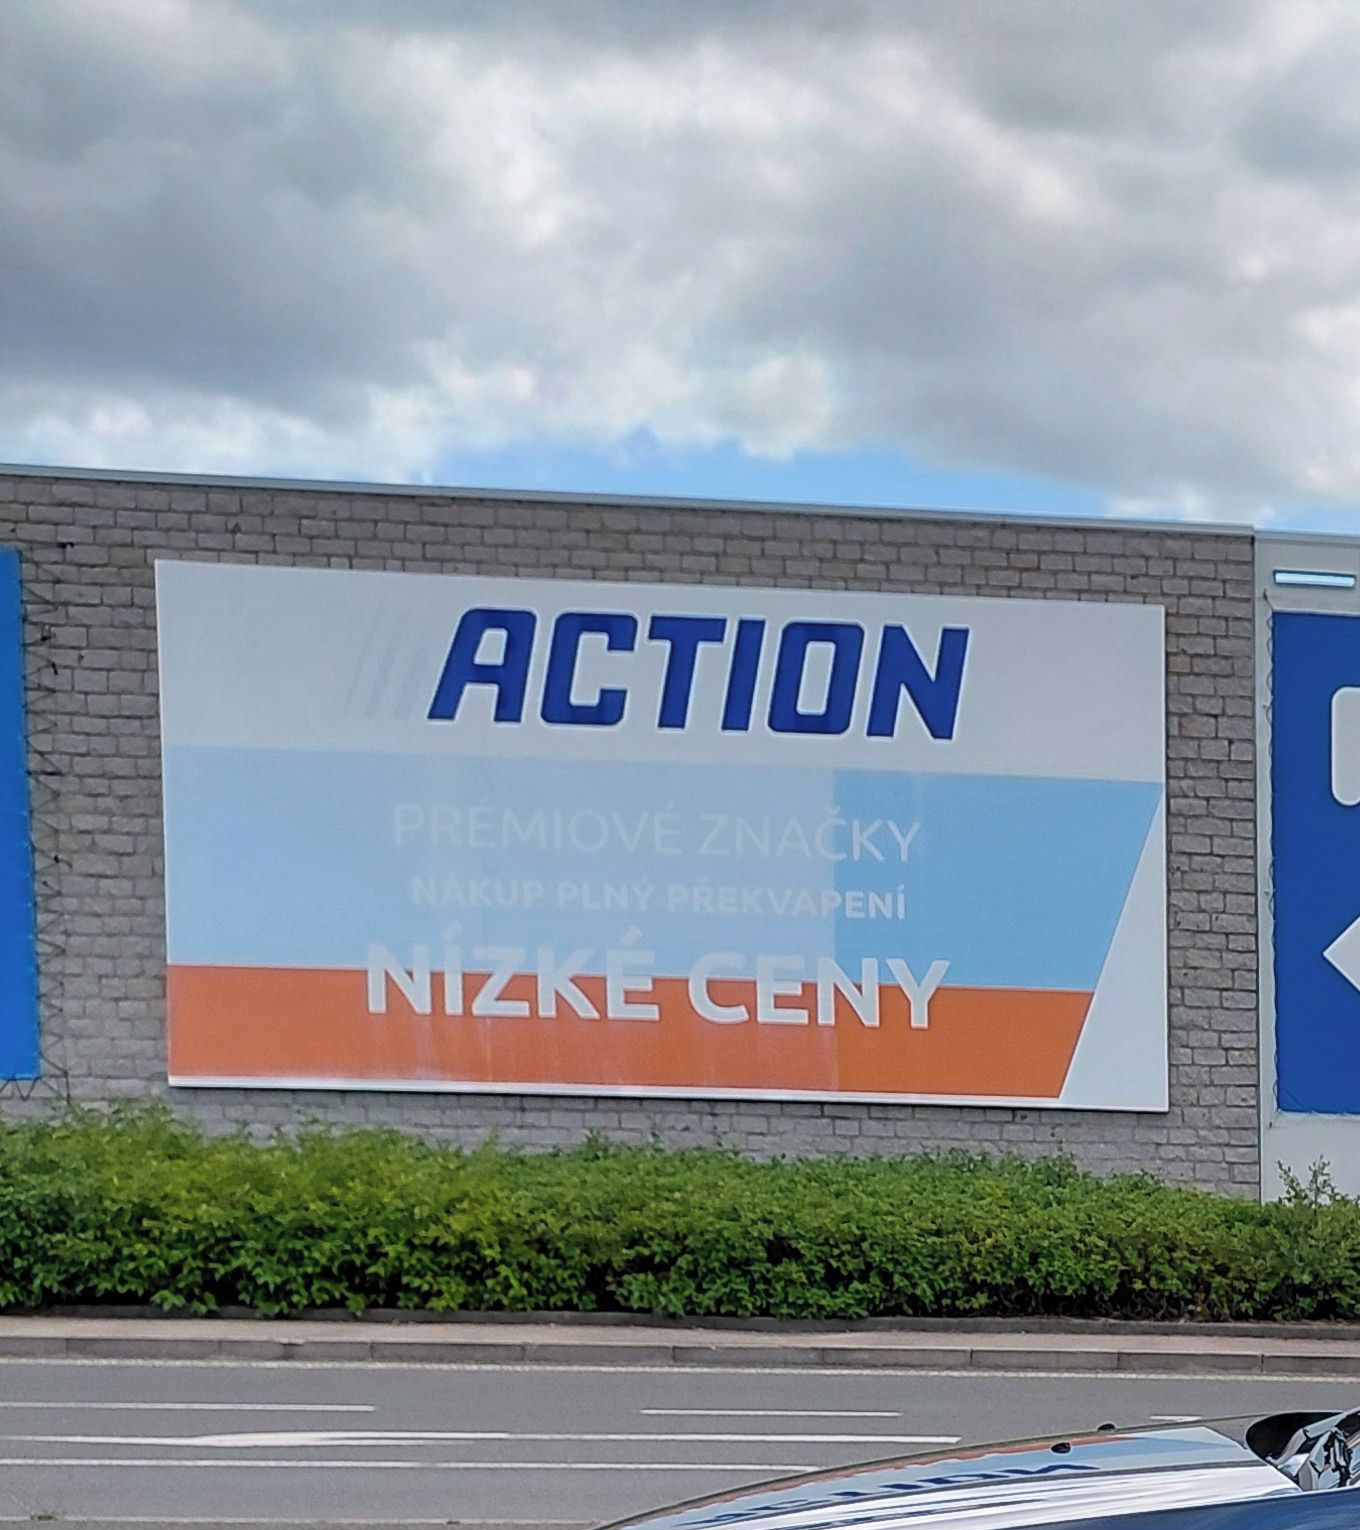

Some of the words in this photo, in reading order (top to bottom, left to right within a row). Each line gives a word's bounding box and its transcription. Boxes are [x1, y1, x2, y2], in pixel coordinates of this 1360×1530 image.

[427, 606, 970, 741] ACTION
[394, 797, 681, 854] PRÉMIOVÉ
[700, 806, 920, 862] ZNAČKY
[558, 875, 653, 912] PLNÝ
[667, 882, 906, 920] PŘEKVAPENÍ
[366, 921, 660, 1021] NÍZKÉ
[688, 950, 951, 1029] CENY
